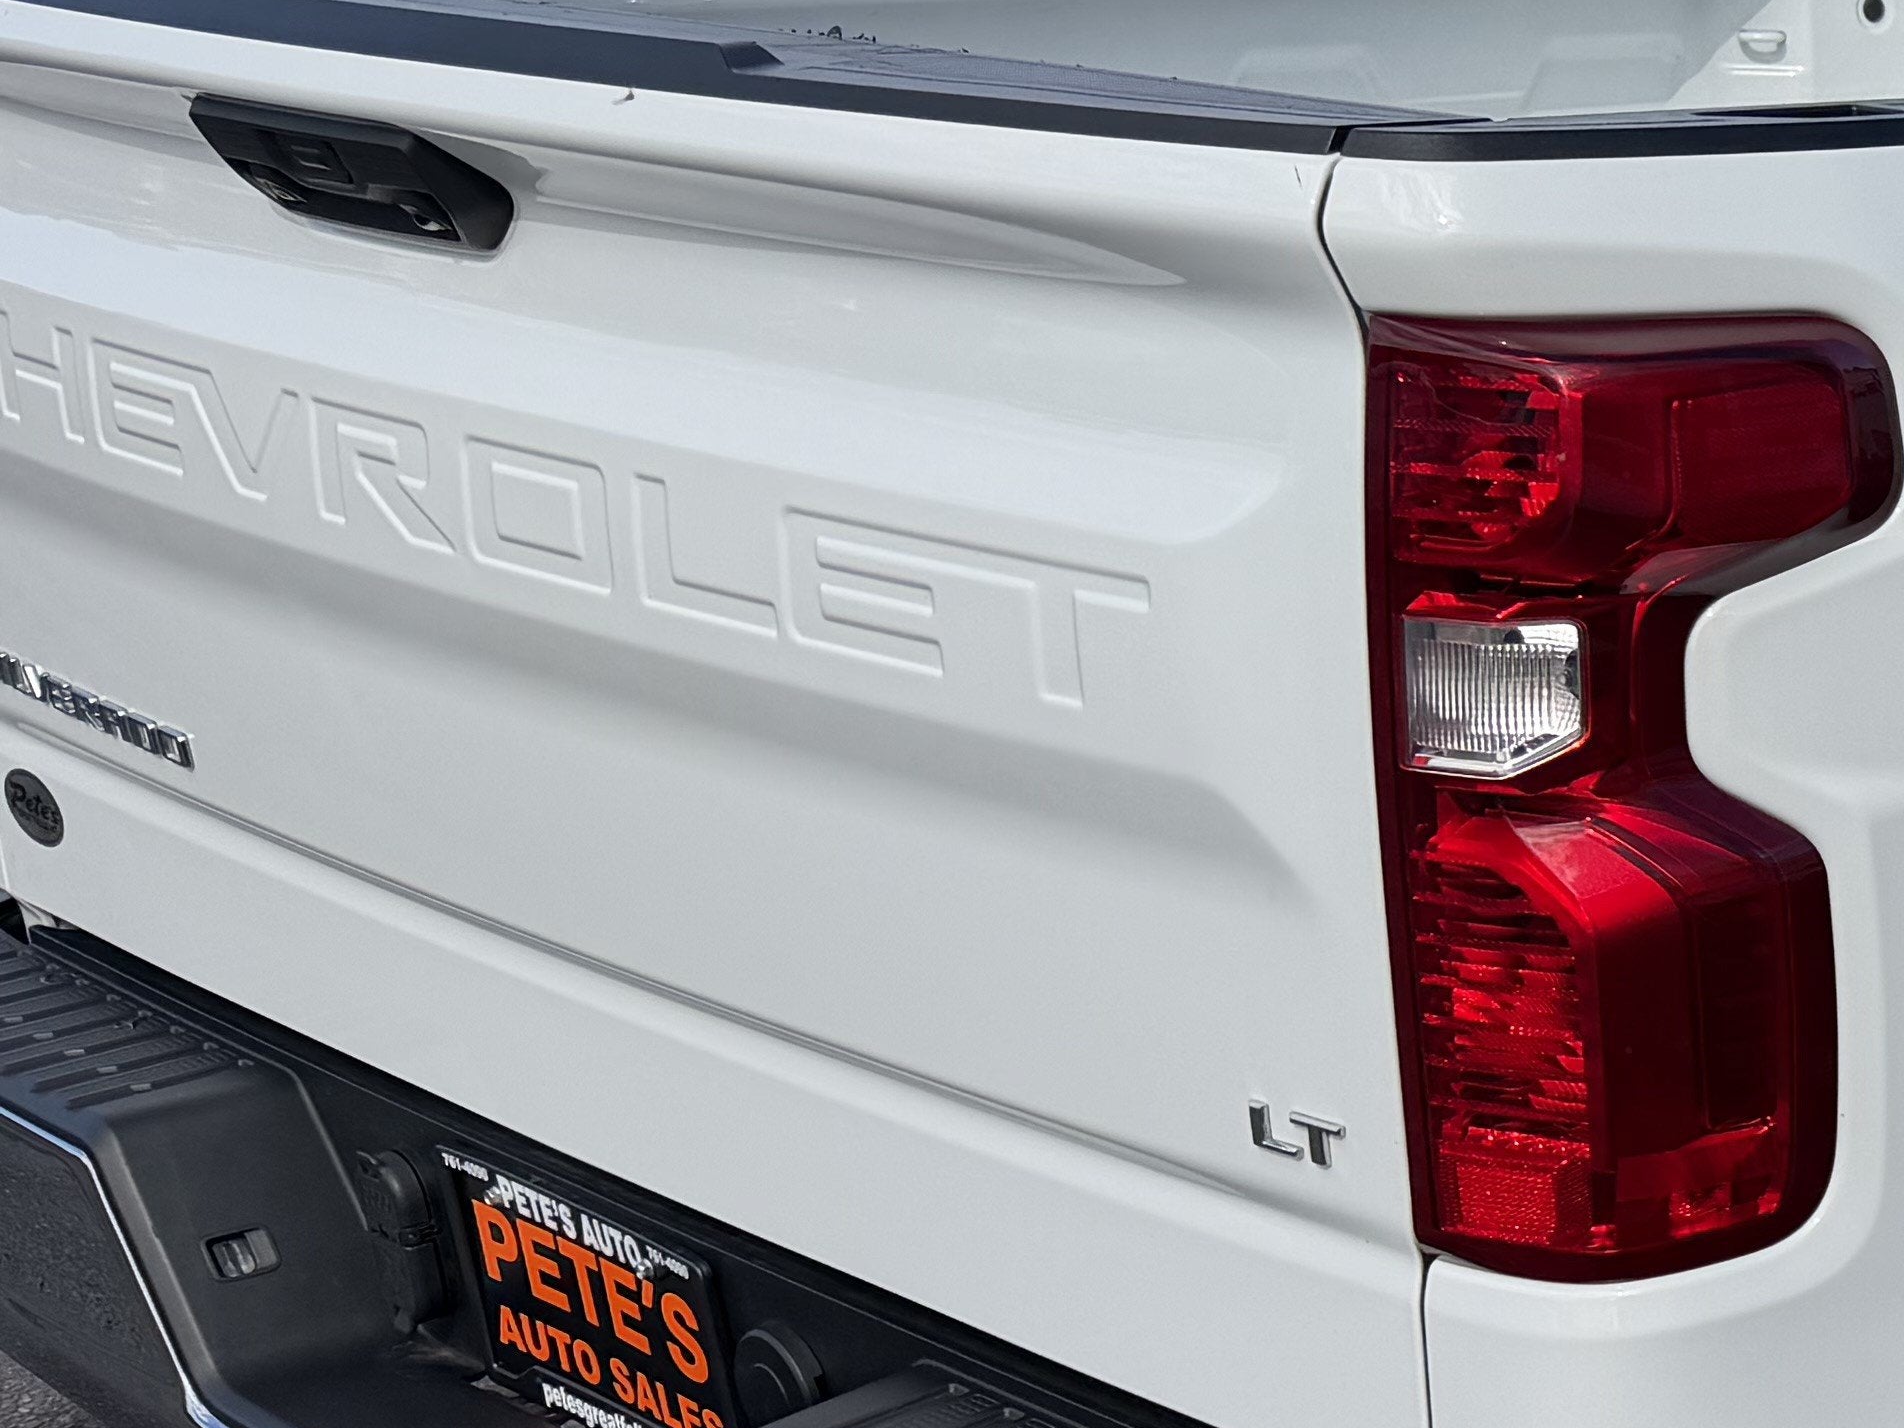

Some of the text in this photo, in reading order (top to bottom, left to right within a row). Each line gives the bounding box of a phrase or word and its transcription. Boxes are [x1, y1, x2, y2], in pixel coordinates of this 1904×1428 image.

[0, 308, 1152, 710] HEVROLET
[0, 652, 196, 772] ILVERADO
[1248, 1098, 1347, 1170] LT
[496, 1173, 642, 1269] PETE'S AUTO
[471, 1198, 709, 1383] PETE'S
[500, 1304, 601, 1386] AUTO
